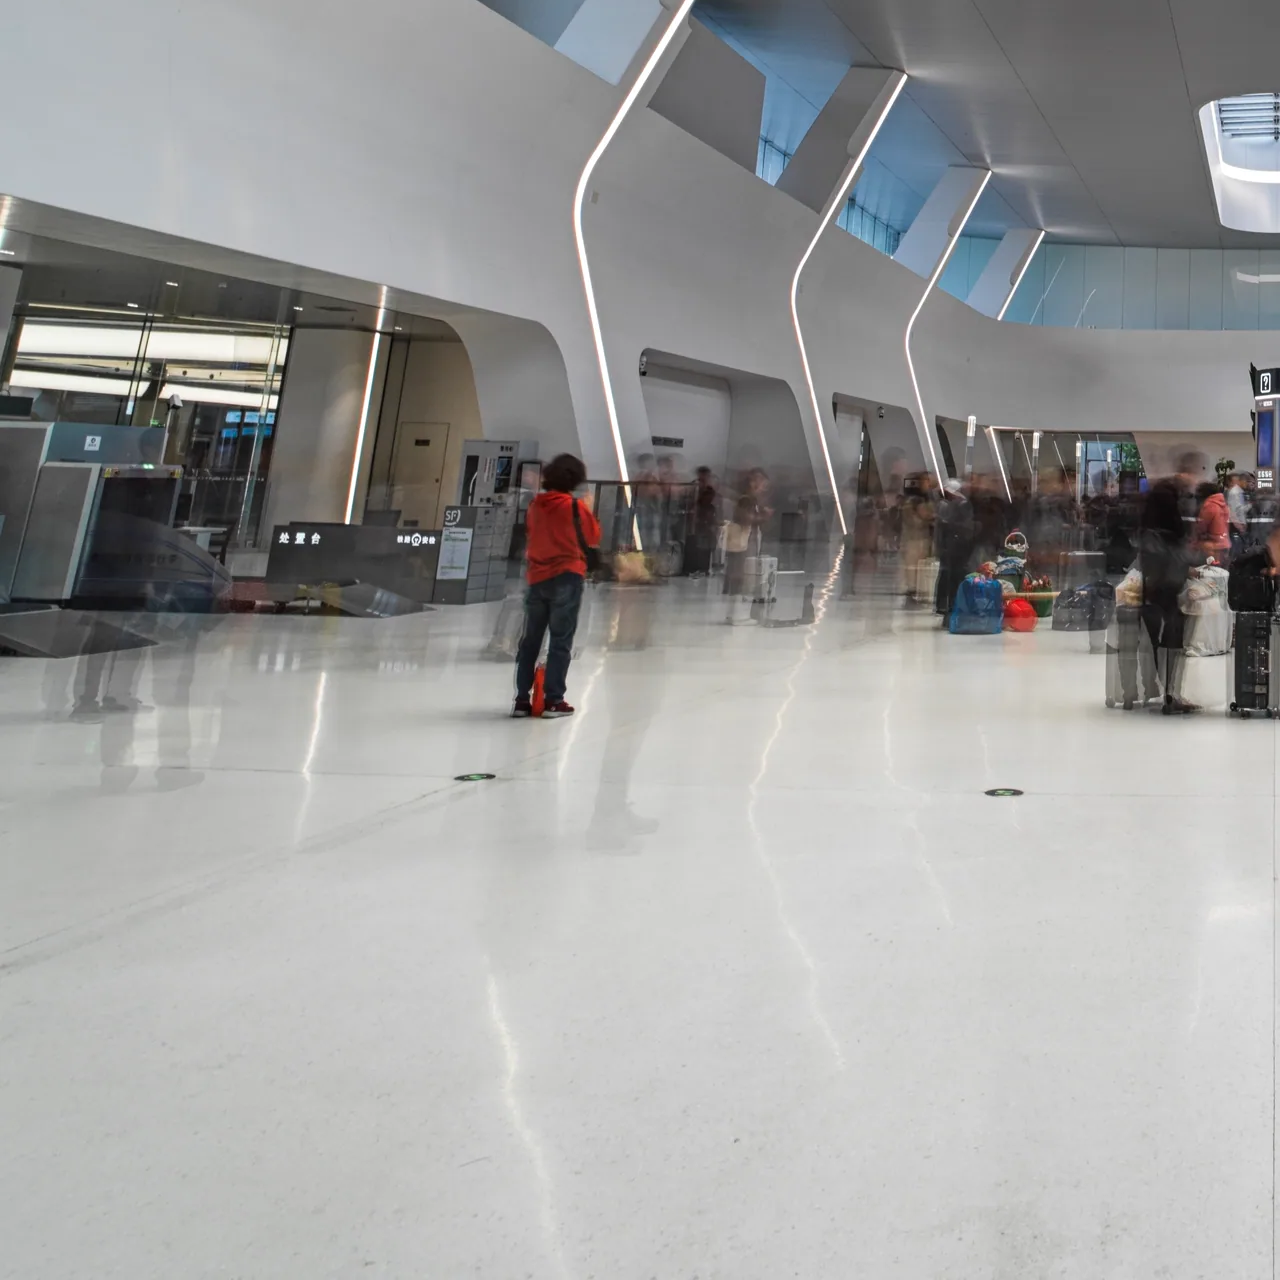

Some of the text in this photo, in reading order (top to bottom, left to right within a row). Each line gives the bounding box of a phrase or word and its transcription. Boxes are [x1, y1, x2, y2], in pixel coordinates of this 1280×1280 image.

[279, 533, 321, 544] 处置台
[422, 536, 435, 544] 安检
